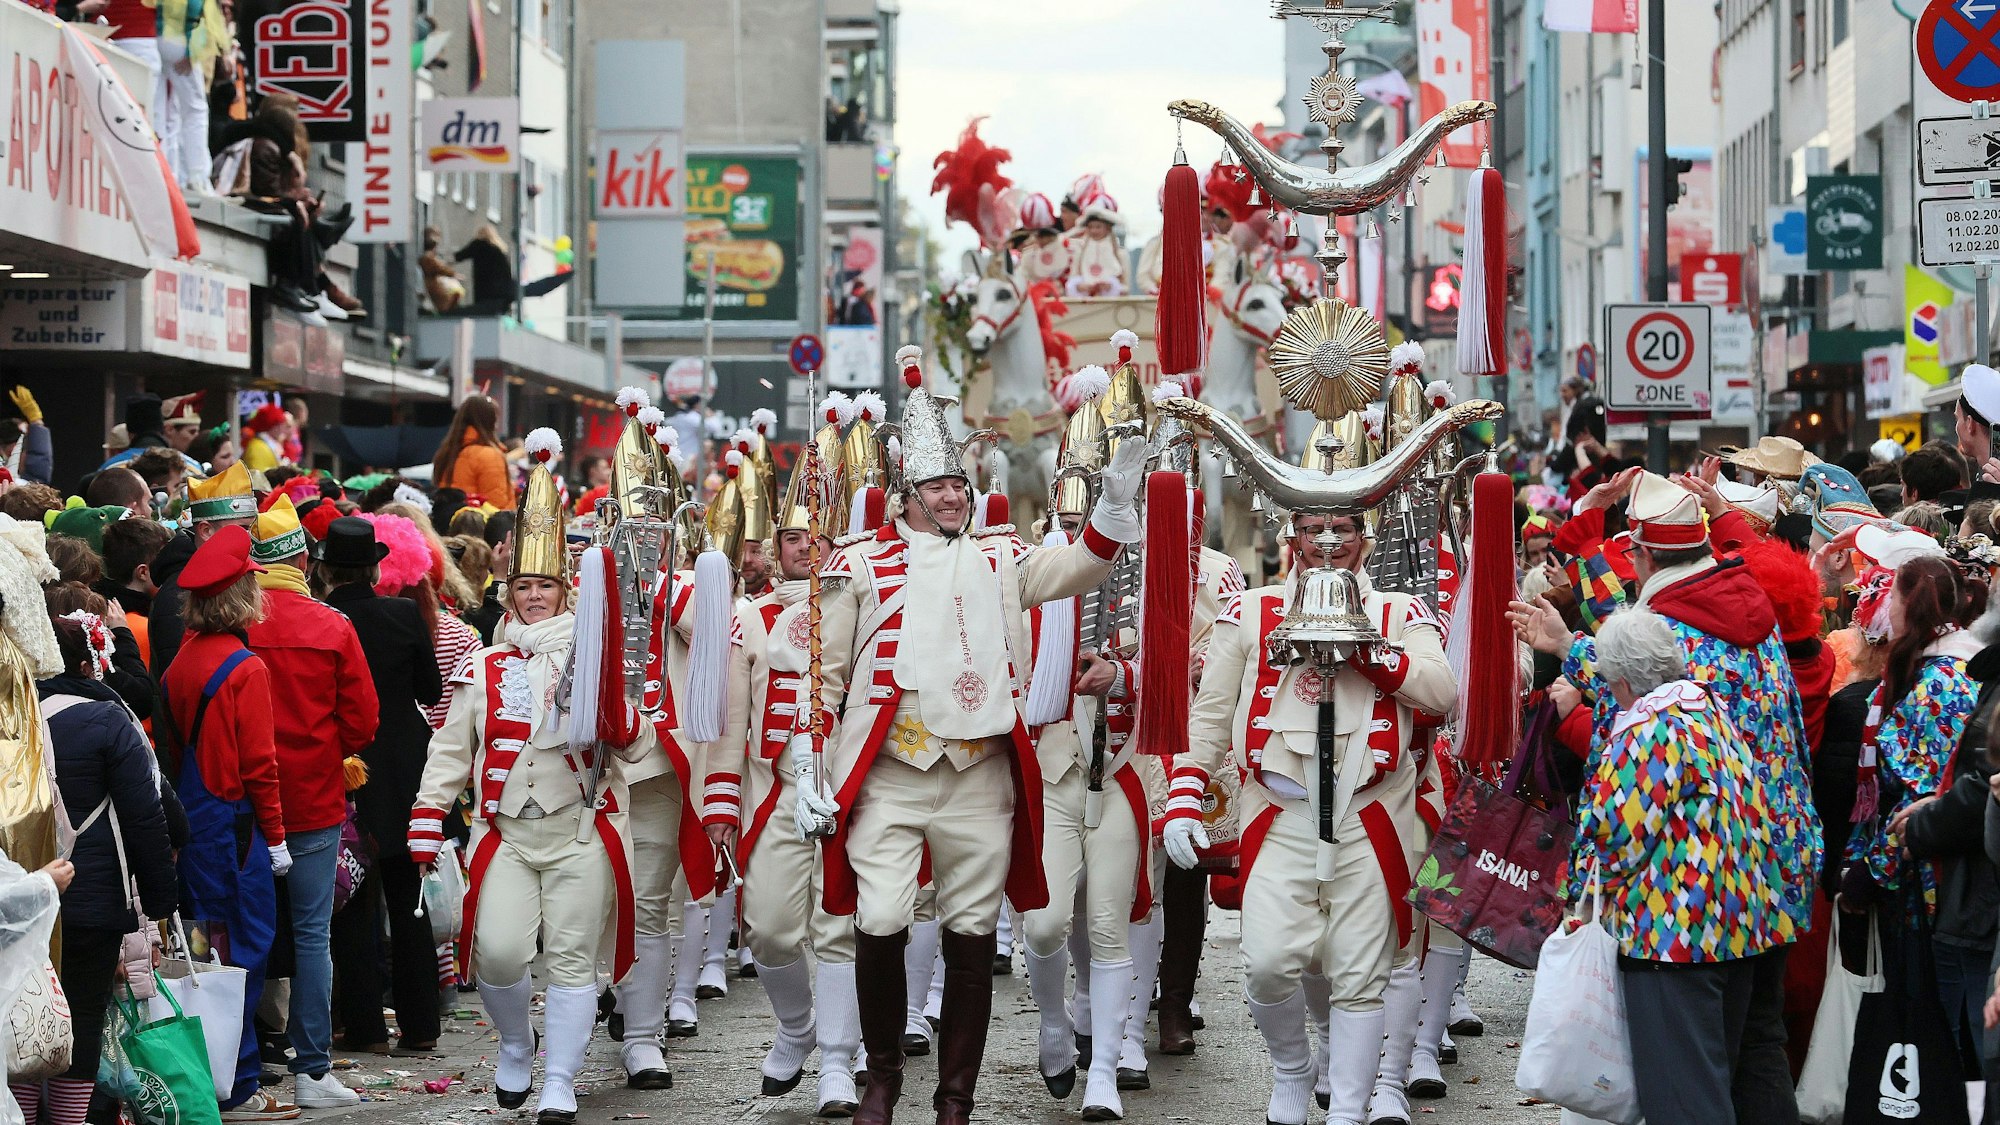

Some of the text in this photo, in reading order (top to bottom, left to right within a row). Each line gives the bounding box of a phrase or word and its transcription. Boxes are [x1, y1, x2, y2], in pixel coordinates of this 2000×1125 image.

[442, 110, 500, 144] dm
[364, 113, 391, 233] TINTE
[1947, 224, 2000, 237] 11.02.20
[4, 284, 116, 304] reparatur
[38, 304, 79, 322] und
[12, 325, 106, 343] Zubehör
[1642, 330, 1680, 361] 20
[1635, 384, 1686, 403] ZONE
[142, 1074, 164, 1097] 1922
